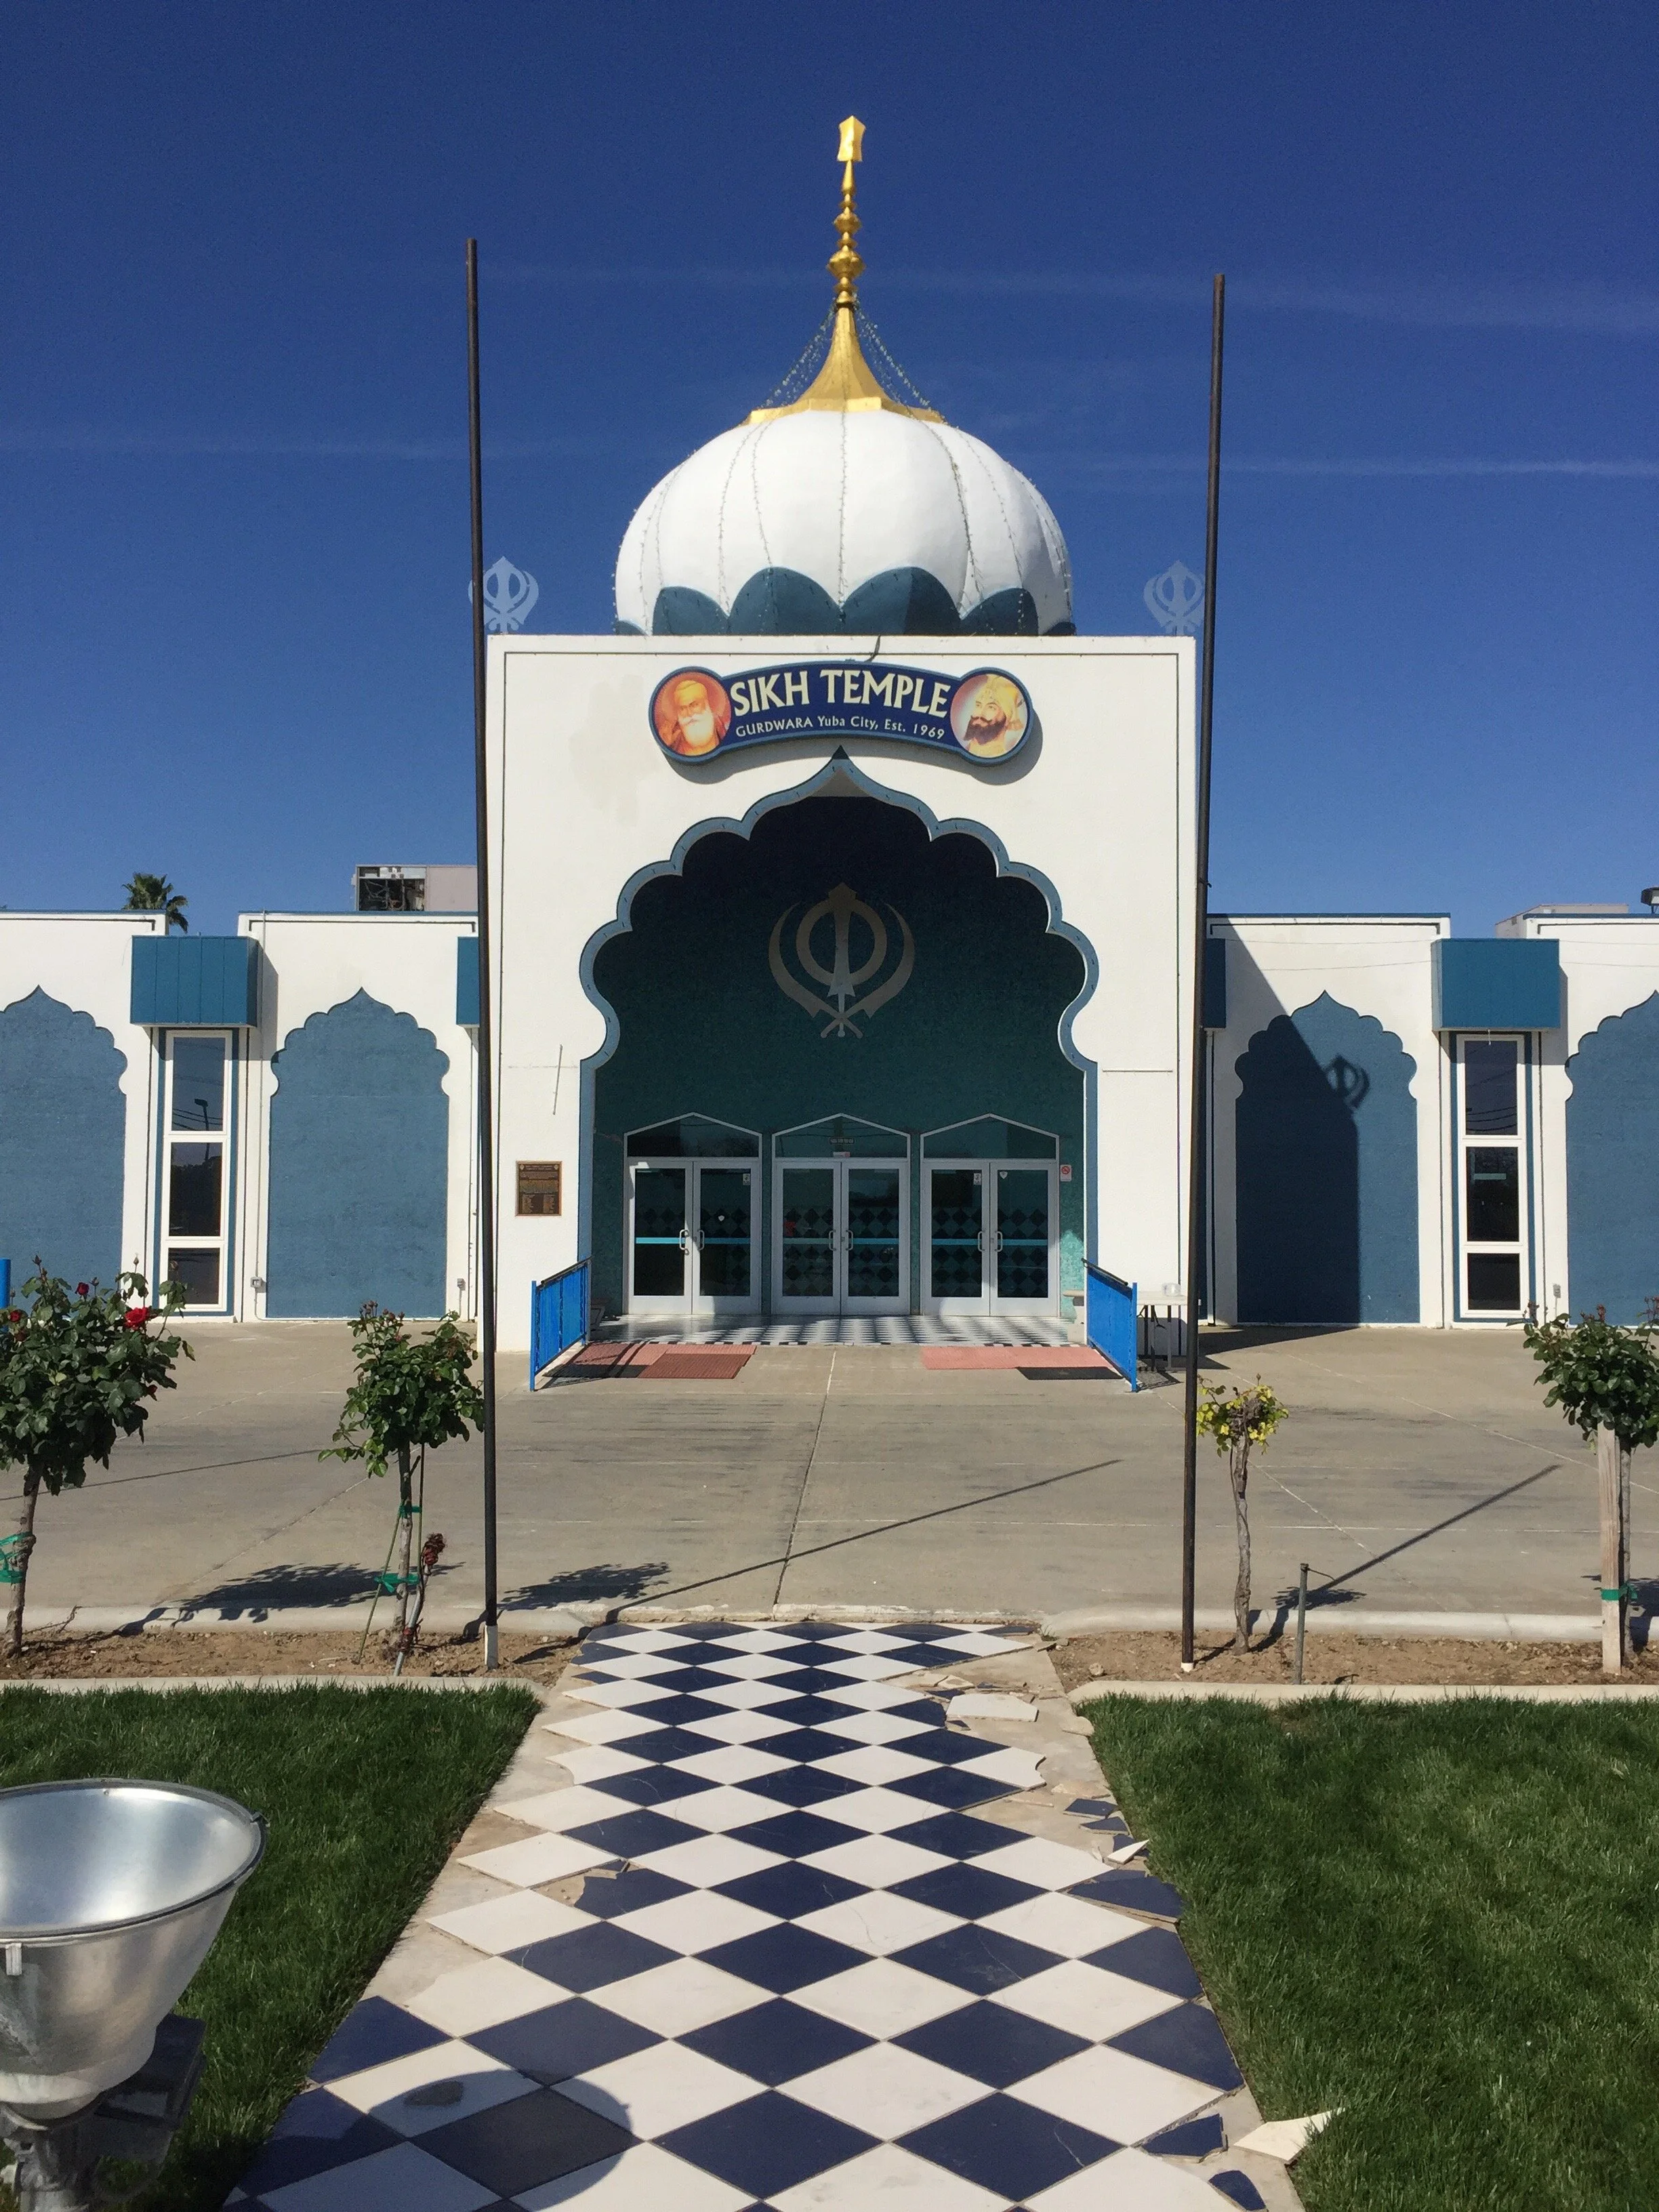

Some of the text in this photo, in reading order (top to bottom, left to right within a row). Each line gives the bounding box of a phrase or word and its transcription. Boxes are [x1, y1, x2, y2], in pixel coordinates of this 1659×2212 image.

[731, 669, 951, 718] SIKH TEMPLE
[736, 715, 945, 740] GURDWARA Yuba City, Est. 1969
